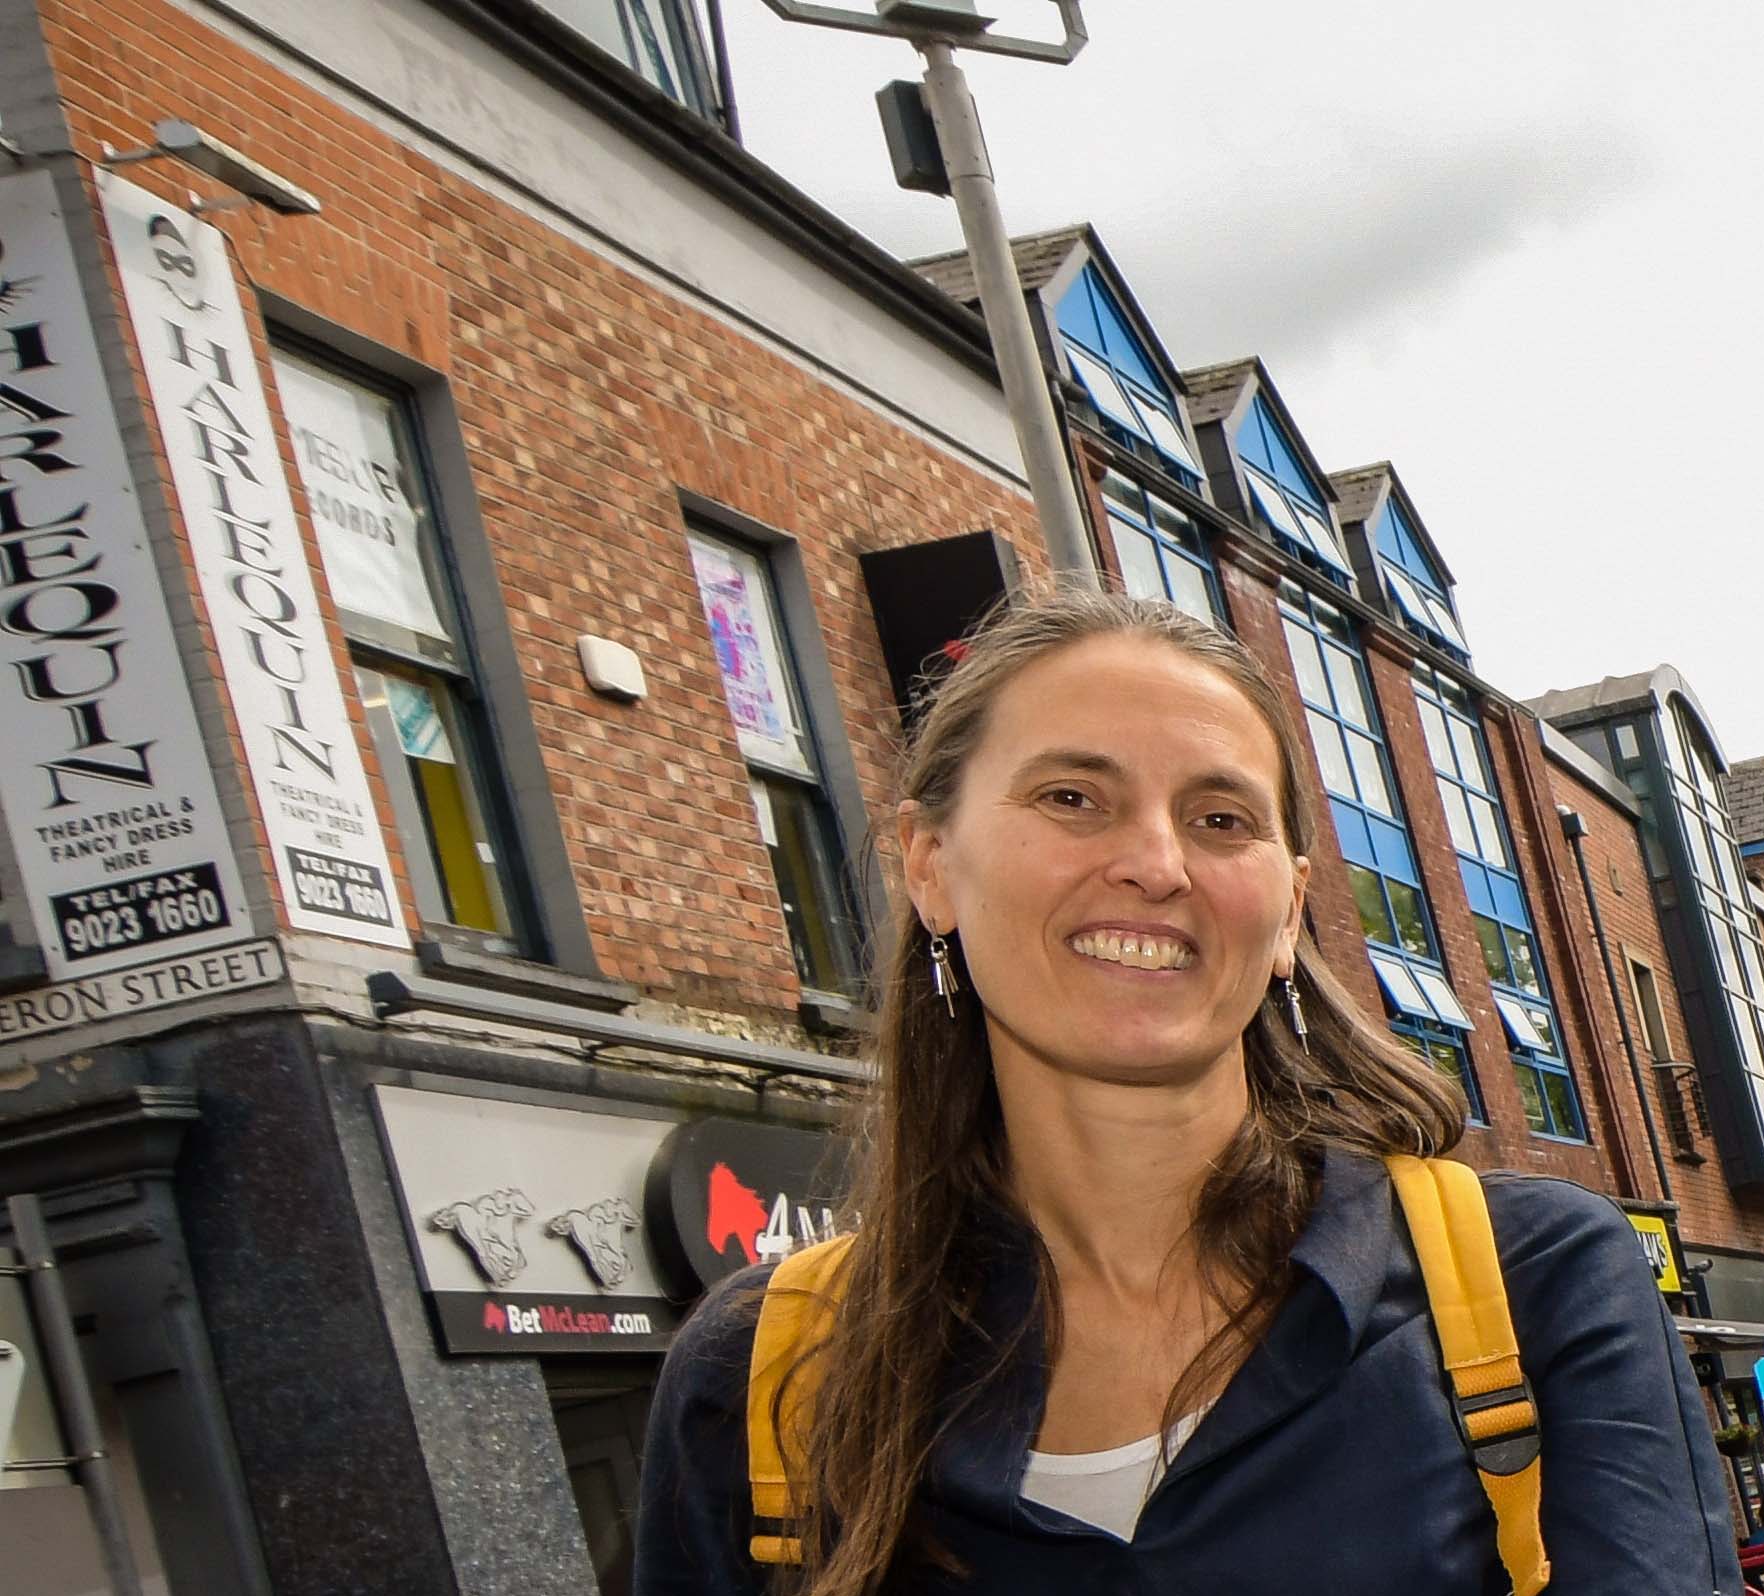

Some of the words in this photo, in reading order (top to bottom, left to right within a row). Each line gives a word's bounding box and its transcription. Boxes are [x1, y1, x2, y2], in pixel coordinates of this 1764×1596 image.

[159, 316, 337, 785] HARLEQUIN
[34, 801, 172, 843] THEATRICAL
[180, 796, 195, 813] &
[50, 834, 119, 864] FANCY
[127, 818, 194, 847] DRESS
[102, 849, 152, 873] HIRE
[69, 871, 199, 912] TEL/FAX
[64, 906, 144, 953] 9023
[147, 888, 221, 934] 1660
[122, 948, 269, 1006] STREET
[505, 1303, 652, 1335] BetMcLean.com
